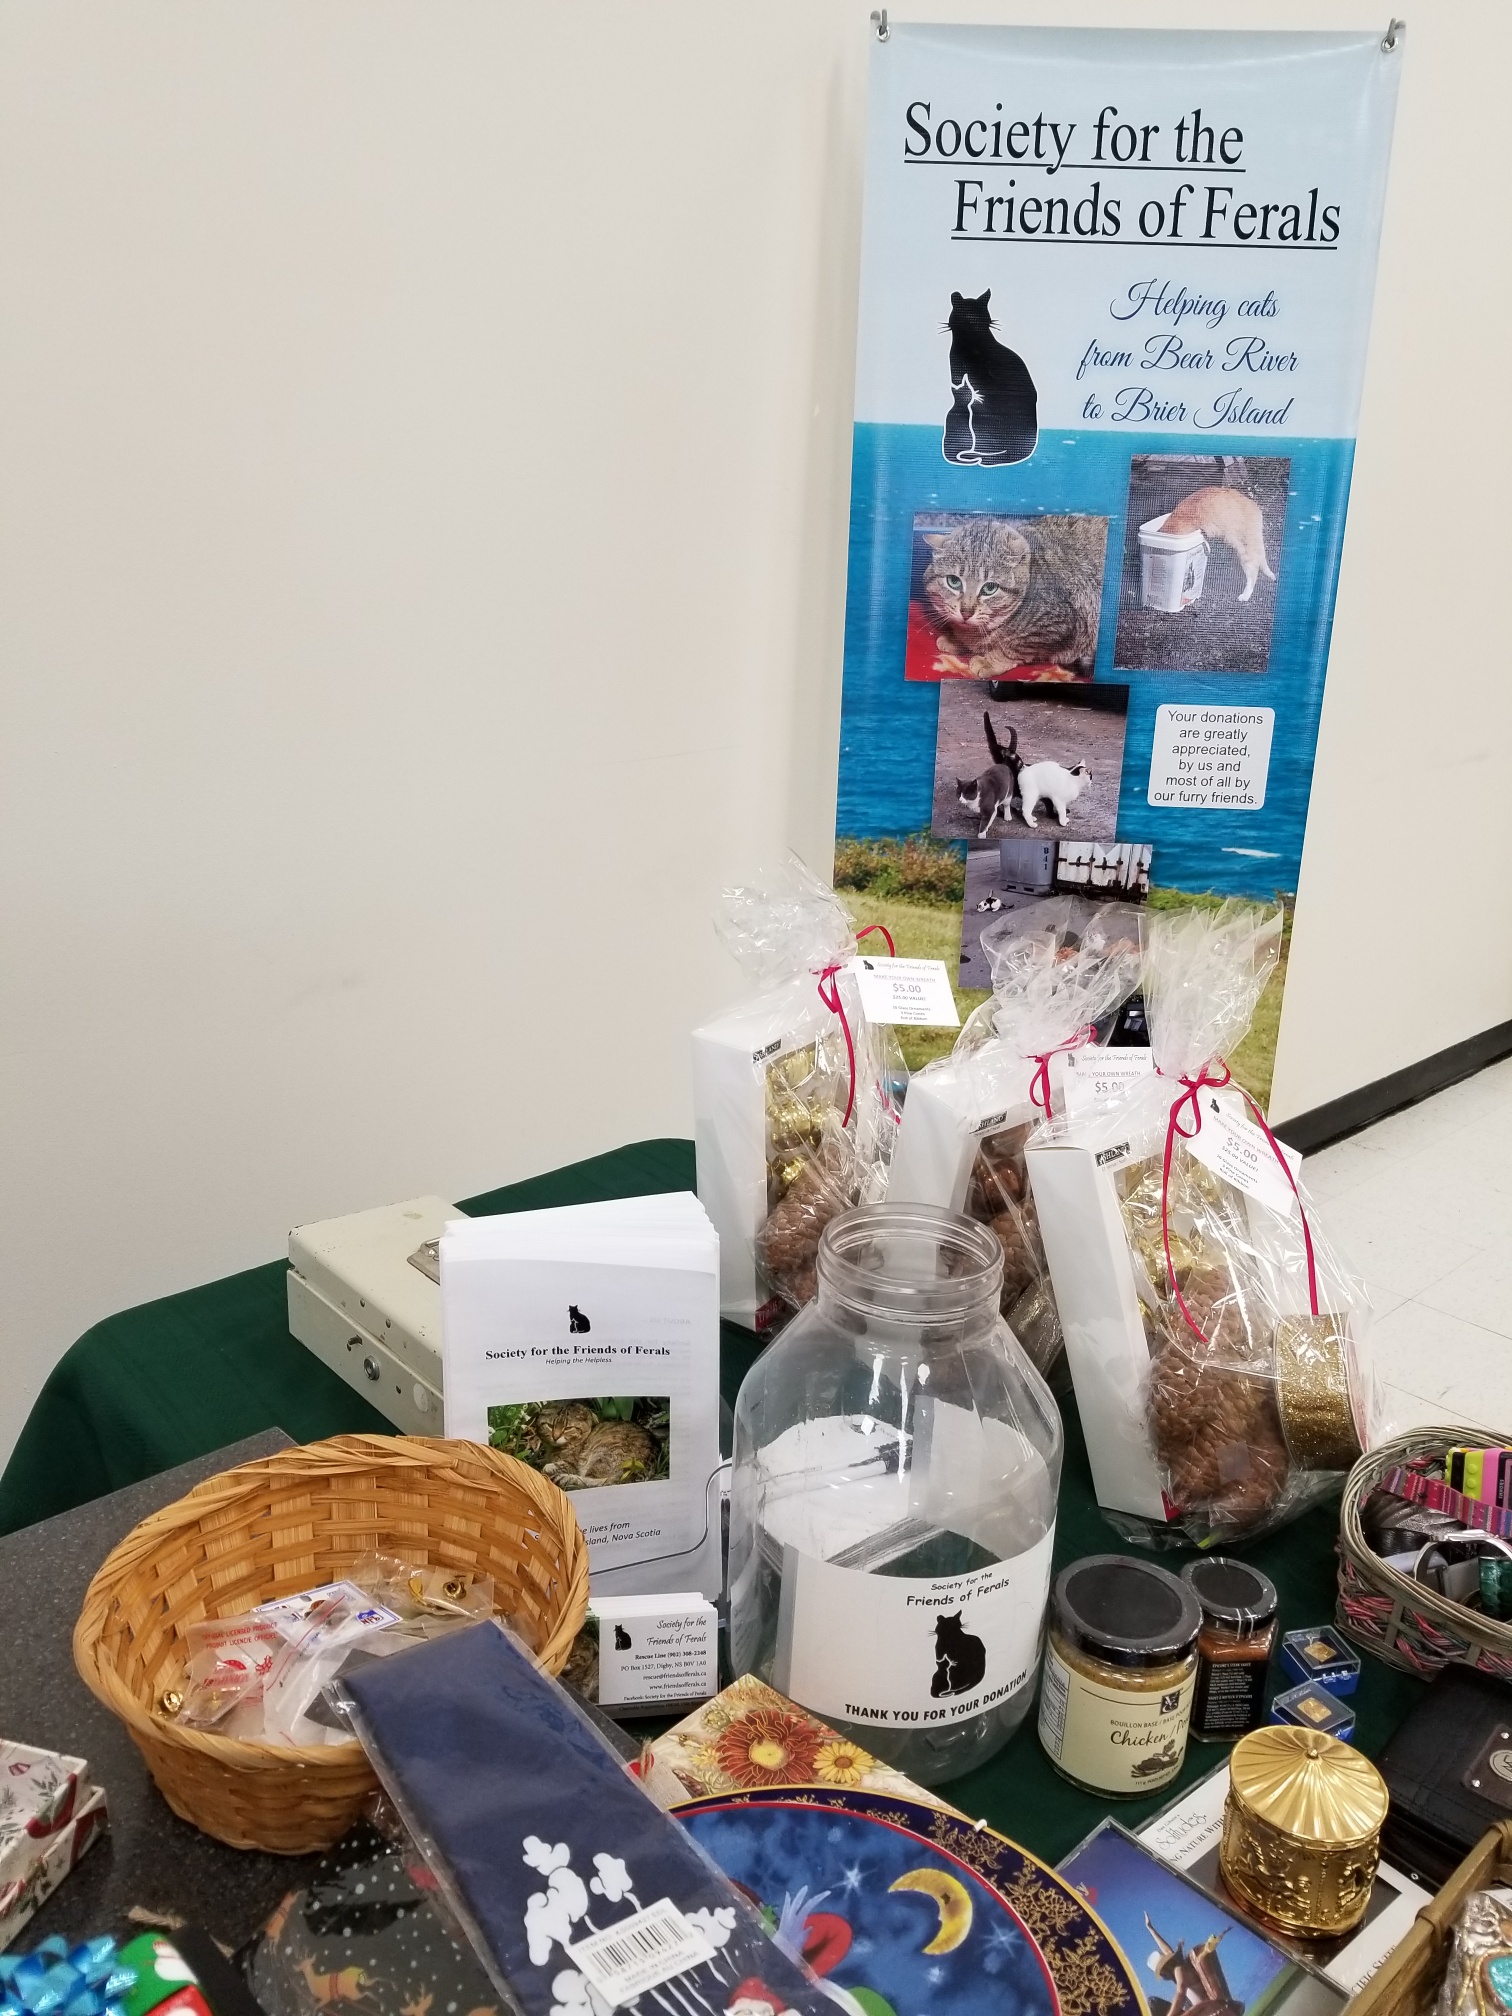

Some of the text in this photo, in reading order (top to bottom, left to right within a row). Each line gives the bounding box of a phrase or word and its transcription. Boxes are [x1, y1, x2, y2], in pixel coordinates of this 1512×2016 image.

[904, 102, 1244, 175] Society for the
[951, 180, 1341, 242] Friends of Ferals
[1110, 279, 1280, 326] Helping cats
[1076, 334, 1299, 380] from Bear River
[1082, 387, 1294, 429] to Brier Island
[1168, 710, 1263, 724] Your donations
[1180, 729, 1248, 742] are greatly
[1172, 745, 1250, 758] appreciated,
[1178, 759, 1241, 772] by us and
[1166, 776, 1251, 790] most of all by
[1154, 791, 1257, 805] our furry friends.
[893, 983, 921, 993] $5.00
[1095, 1081, 1124, 1093] $500
[1226, 1137, 1258, 1162] $5.00
[1221, 1145, 1238, 1160] $25.00
[1240, 1158, 1258, 1172] VALUE!
[486, 1346, 670, 1360] Society for the Friends of Ferals
[589, 1523, 608, 1534] lives
[610, 1521, 630, 1531] from
[612, 1533, 634, 1542] Nova
[635, 1529, 660, 1539] Scotia
[931, 1572, 993, 1591] Society for the
[907, 1578, 1009, 1606] Friends of Ferals
[253, 1622, 277, 1631] PRODUCT
[361, 1616, 380, 1624] NFL
[657, 1616, 706, 1632] Society for the
[647, 1632, 706, 1646] Friends of Ferals
[650, 1682, 706, 1690] www.friendsofferals.ca
[845, 1669, 1027, 1721] THANK YOU FOR YOUR DONATION
[1111, 1720, 1142, 1728] BOUILLON
[1111, 1730, 1167, 1746] Chicken
[1179, 1833, 1208, 1856] NATURE
